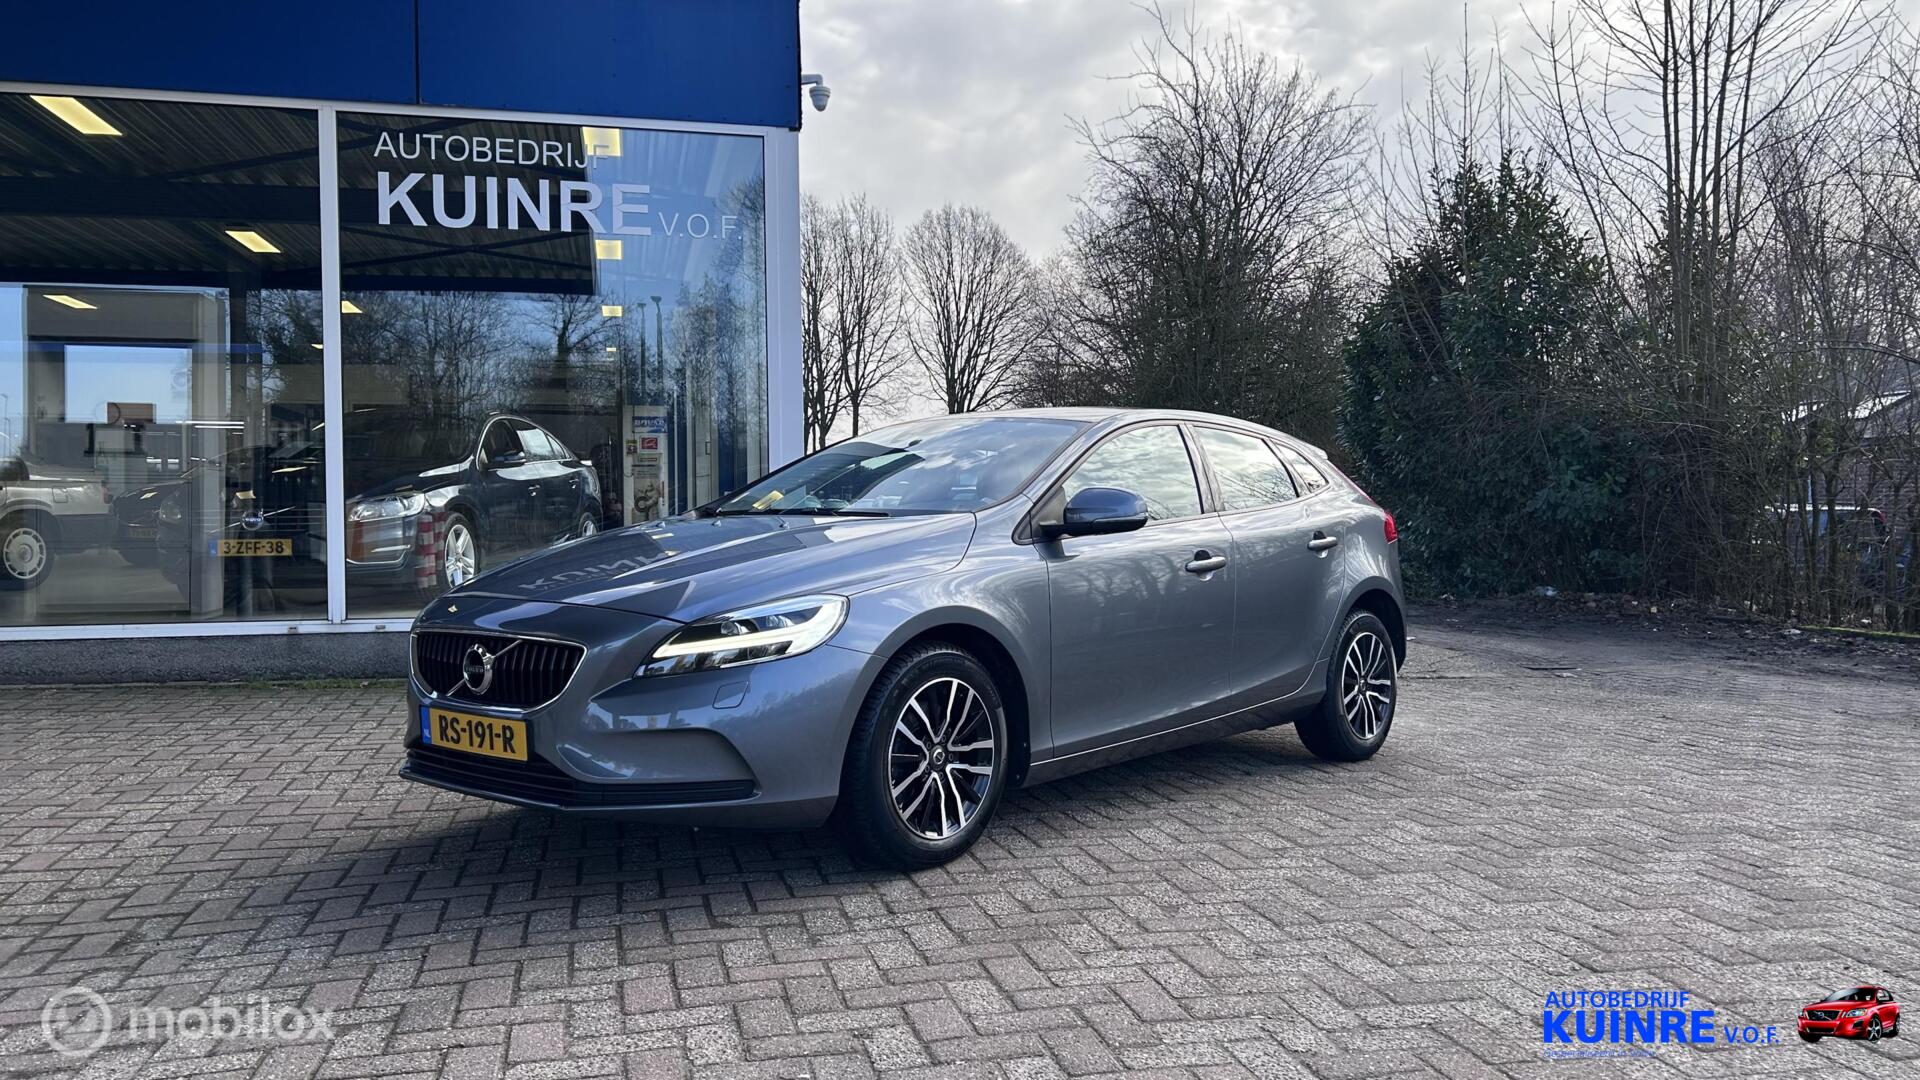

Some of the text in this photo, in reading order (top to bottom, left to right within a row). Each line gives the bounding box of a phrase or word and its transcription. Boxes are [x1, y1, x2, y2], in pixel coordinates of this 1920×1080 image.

[374, 131, 609, 170] AUTOBEDRIJF
[377, 171, 743, 240] KUINRE V.O.F.
[223, 541, 285, 555] 3-ZFF-38
[438, 714, 516, 754] RS-191-R
